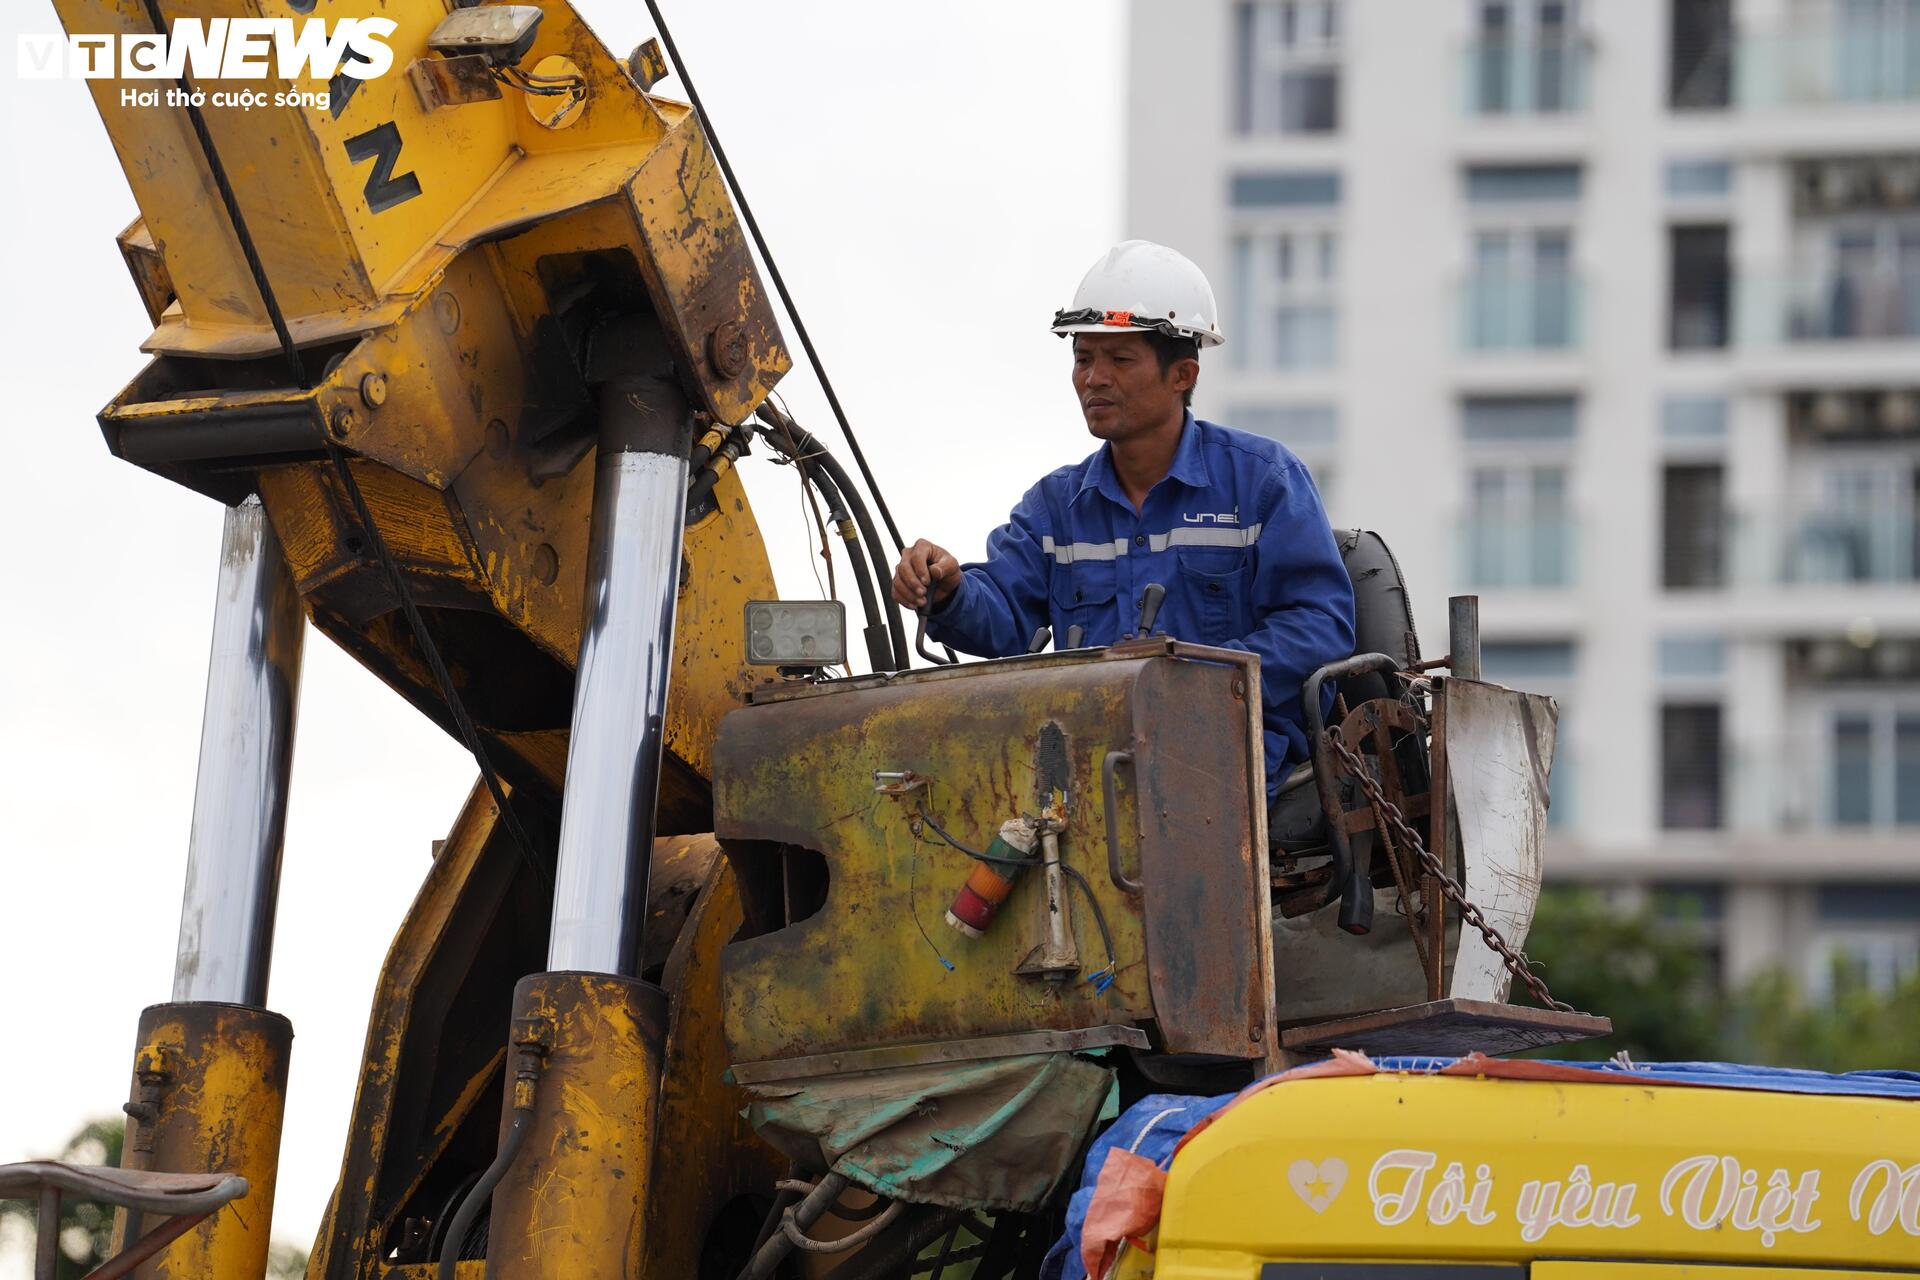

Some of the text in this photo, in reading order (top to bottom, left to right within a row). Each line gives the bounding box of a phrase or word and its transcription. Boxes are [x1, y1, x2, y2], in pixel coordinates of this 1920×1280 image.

[1368, 1149, 1496, 1225] Tôi
[1516, 1165, 1640, 1242] yêu
[1660, 1155, 1821, 1247] Việt
